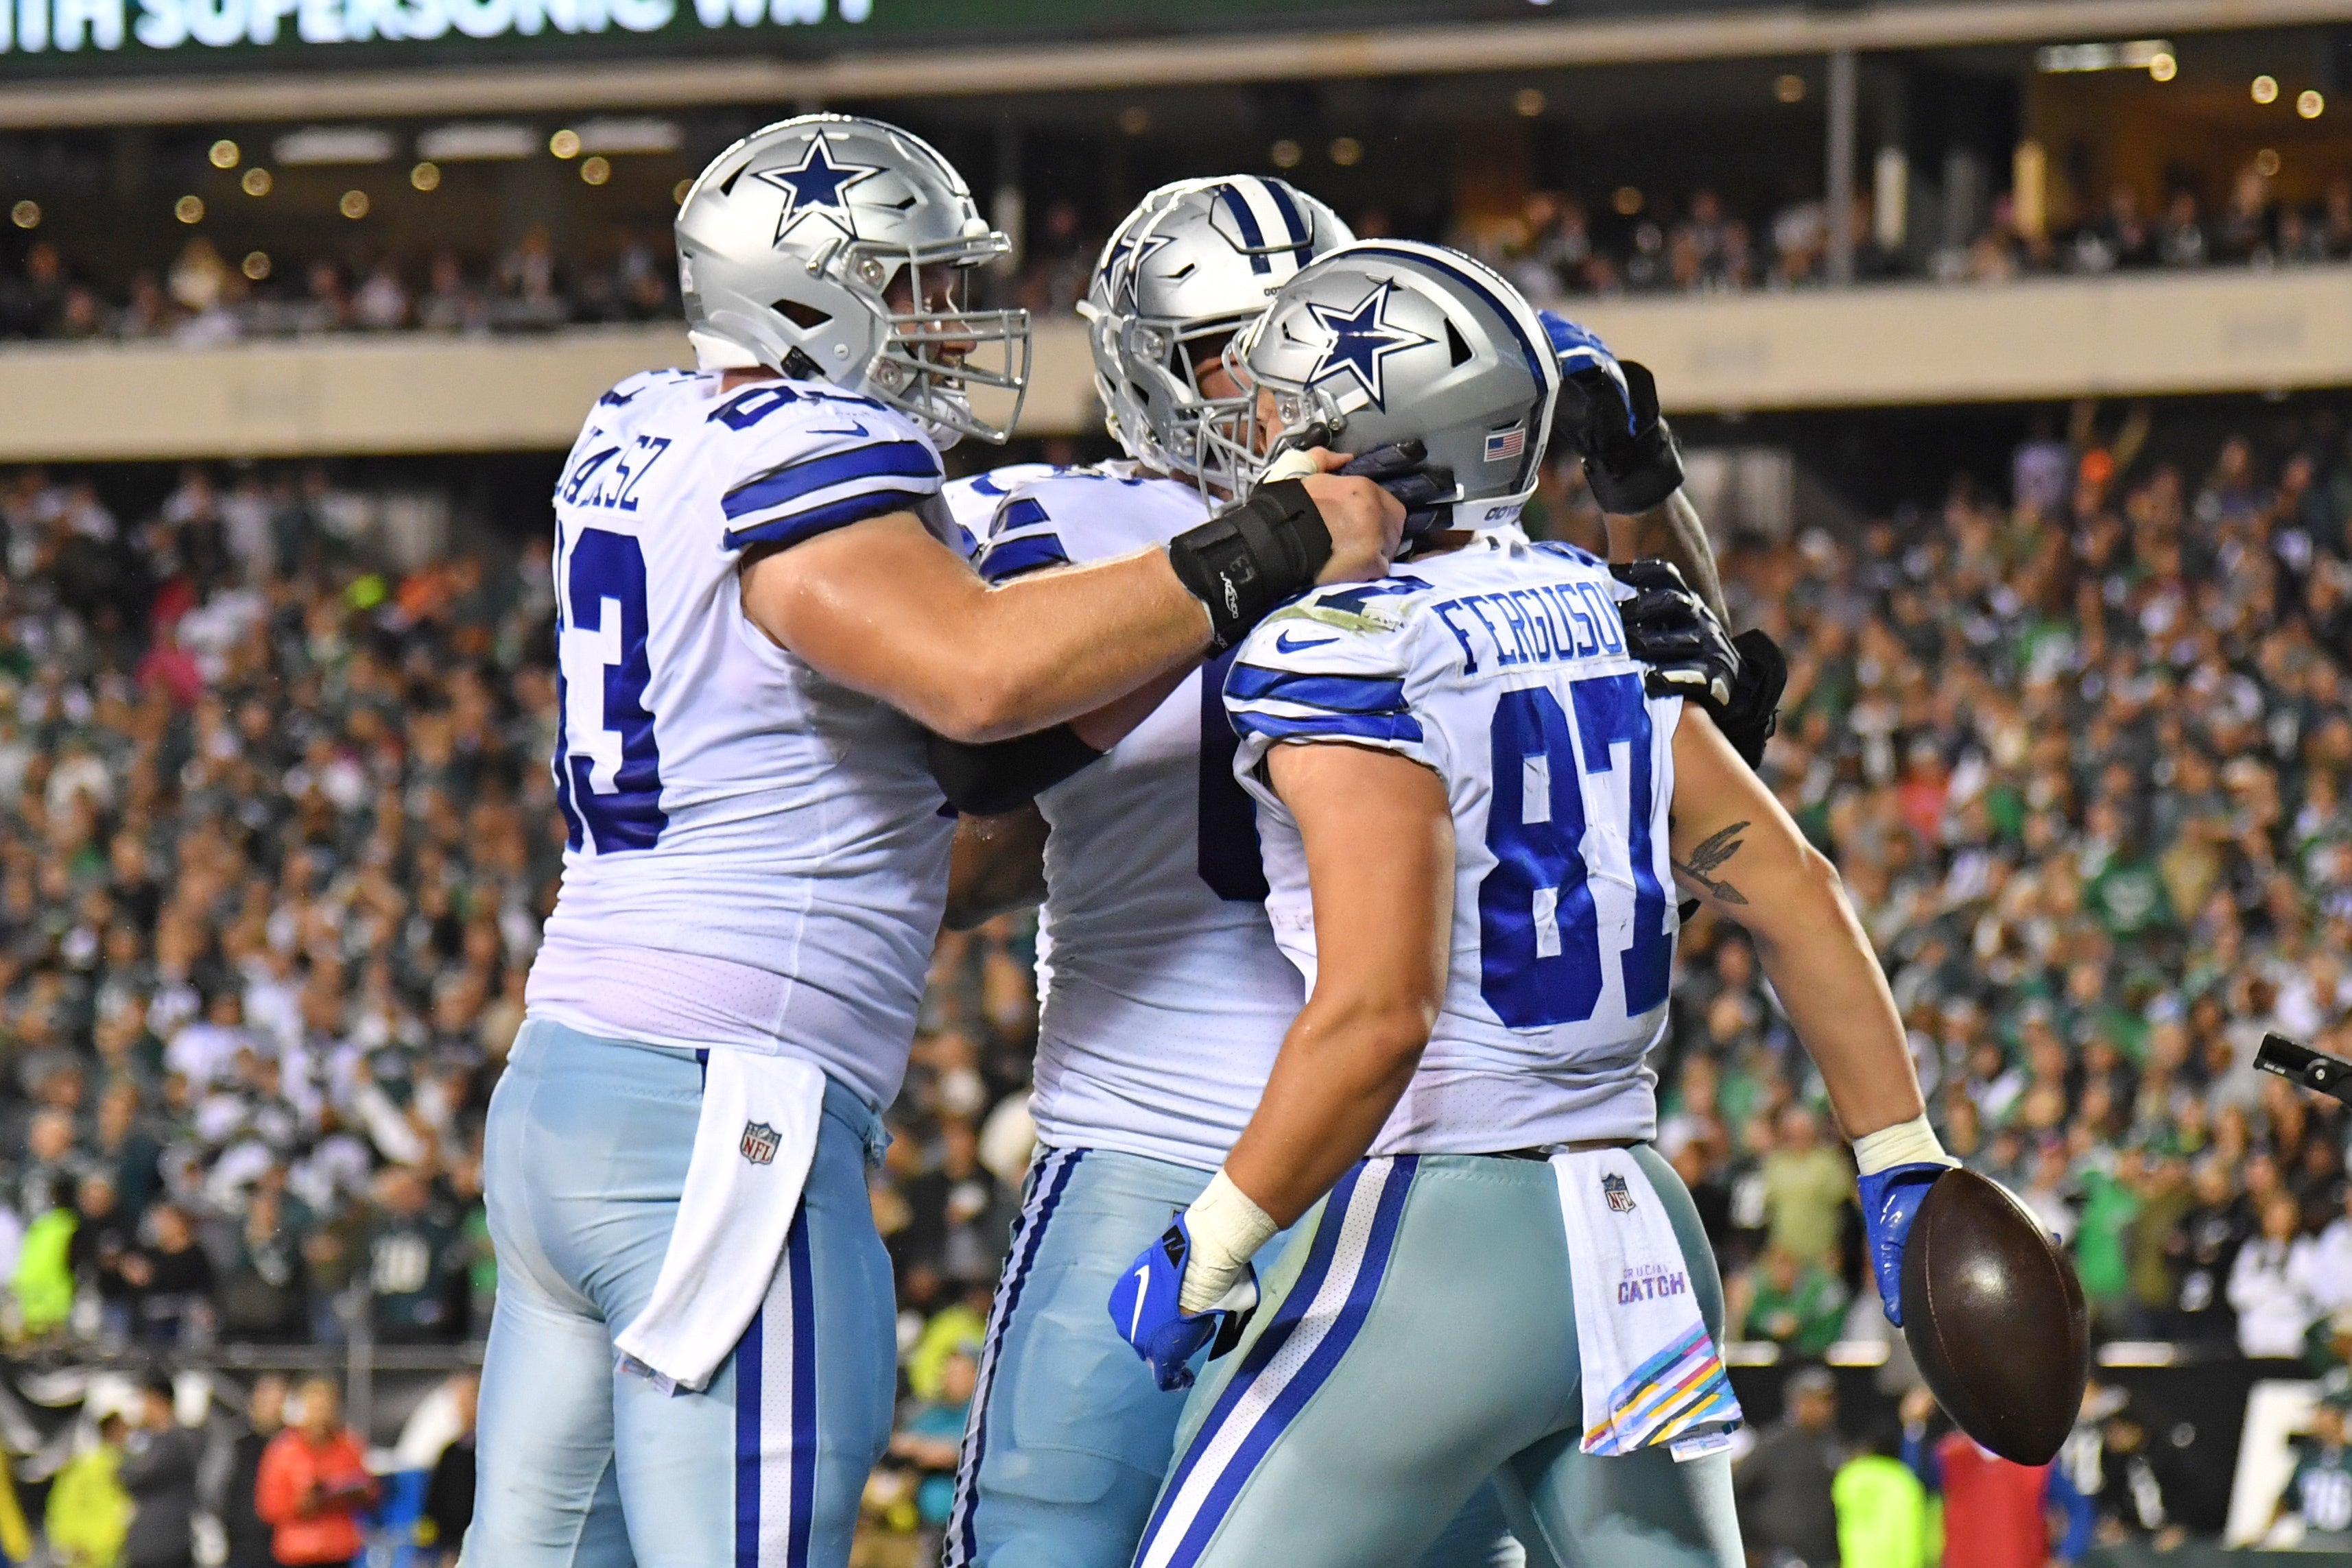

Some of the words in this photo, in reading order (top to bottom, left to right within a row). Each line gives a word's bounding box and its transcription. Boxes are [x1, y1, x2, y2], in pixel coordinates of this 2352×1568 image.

[556, 520, 669, 856] 3
[1479, 672, 1672, 1029] 87
[743, 1136, 770, 1162] NFL
[1608, 1191, 1633, 1210] NFL
[1618, 1272, 1686, 1305] CATCH
